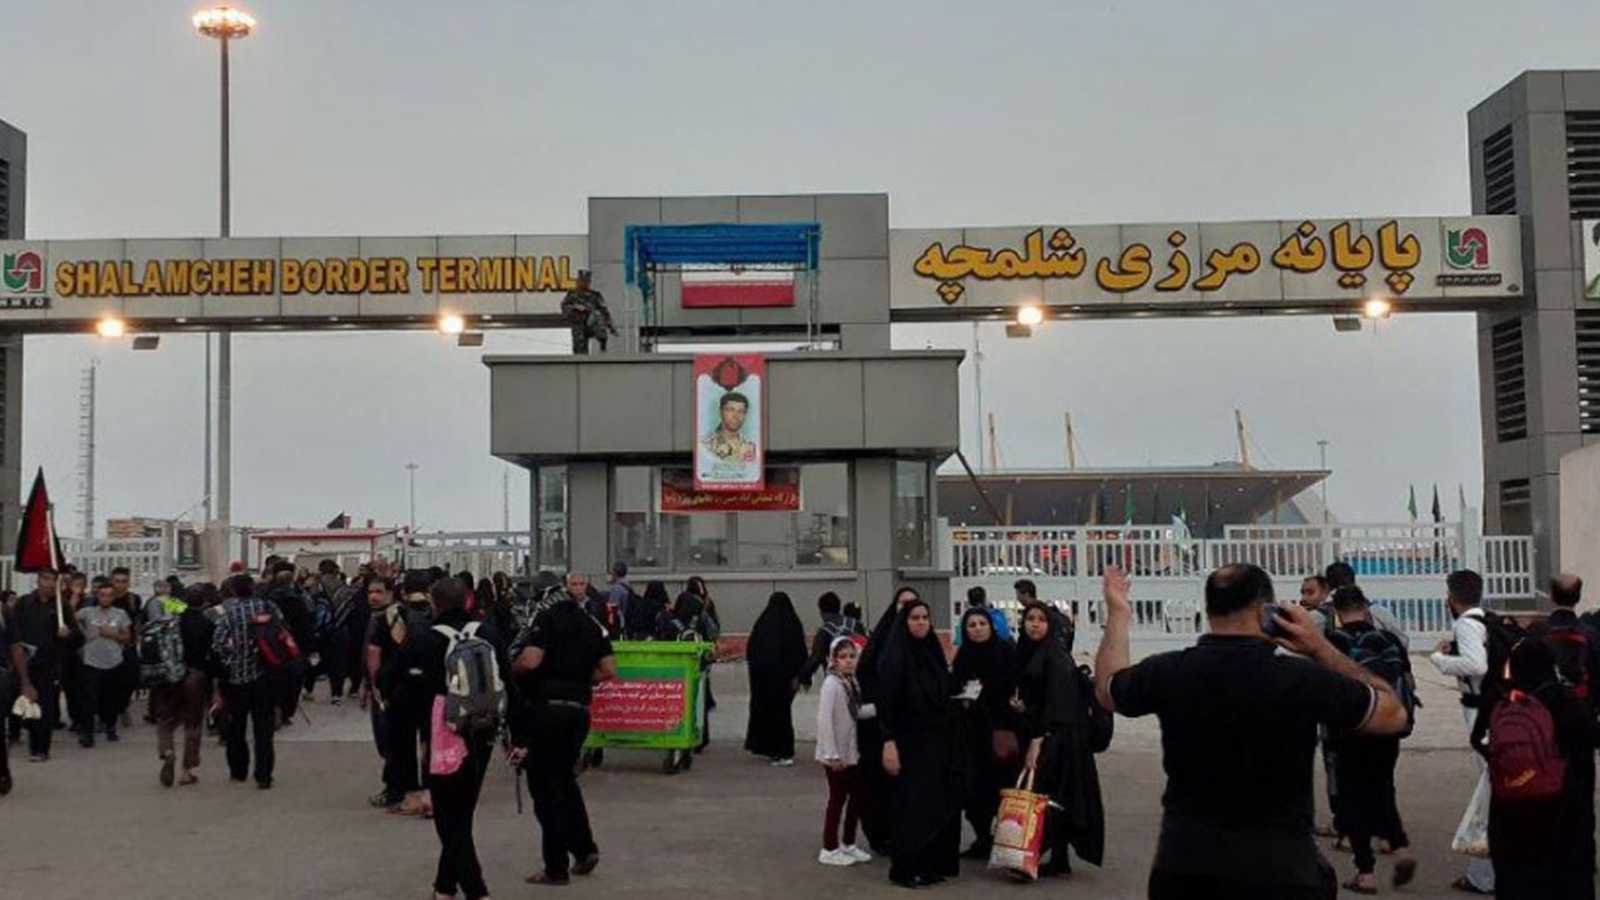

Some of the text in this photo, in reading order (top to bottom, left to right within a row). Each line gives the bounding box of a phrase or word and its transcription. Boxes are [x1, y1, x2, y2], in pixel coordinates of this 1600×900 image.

[56, 255, 578, 297] SHALAMCHEH BORDER TERMINAL
[913, 220, 1422, 304] پایانه مرزی شلمچه
